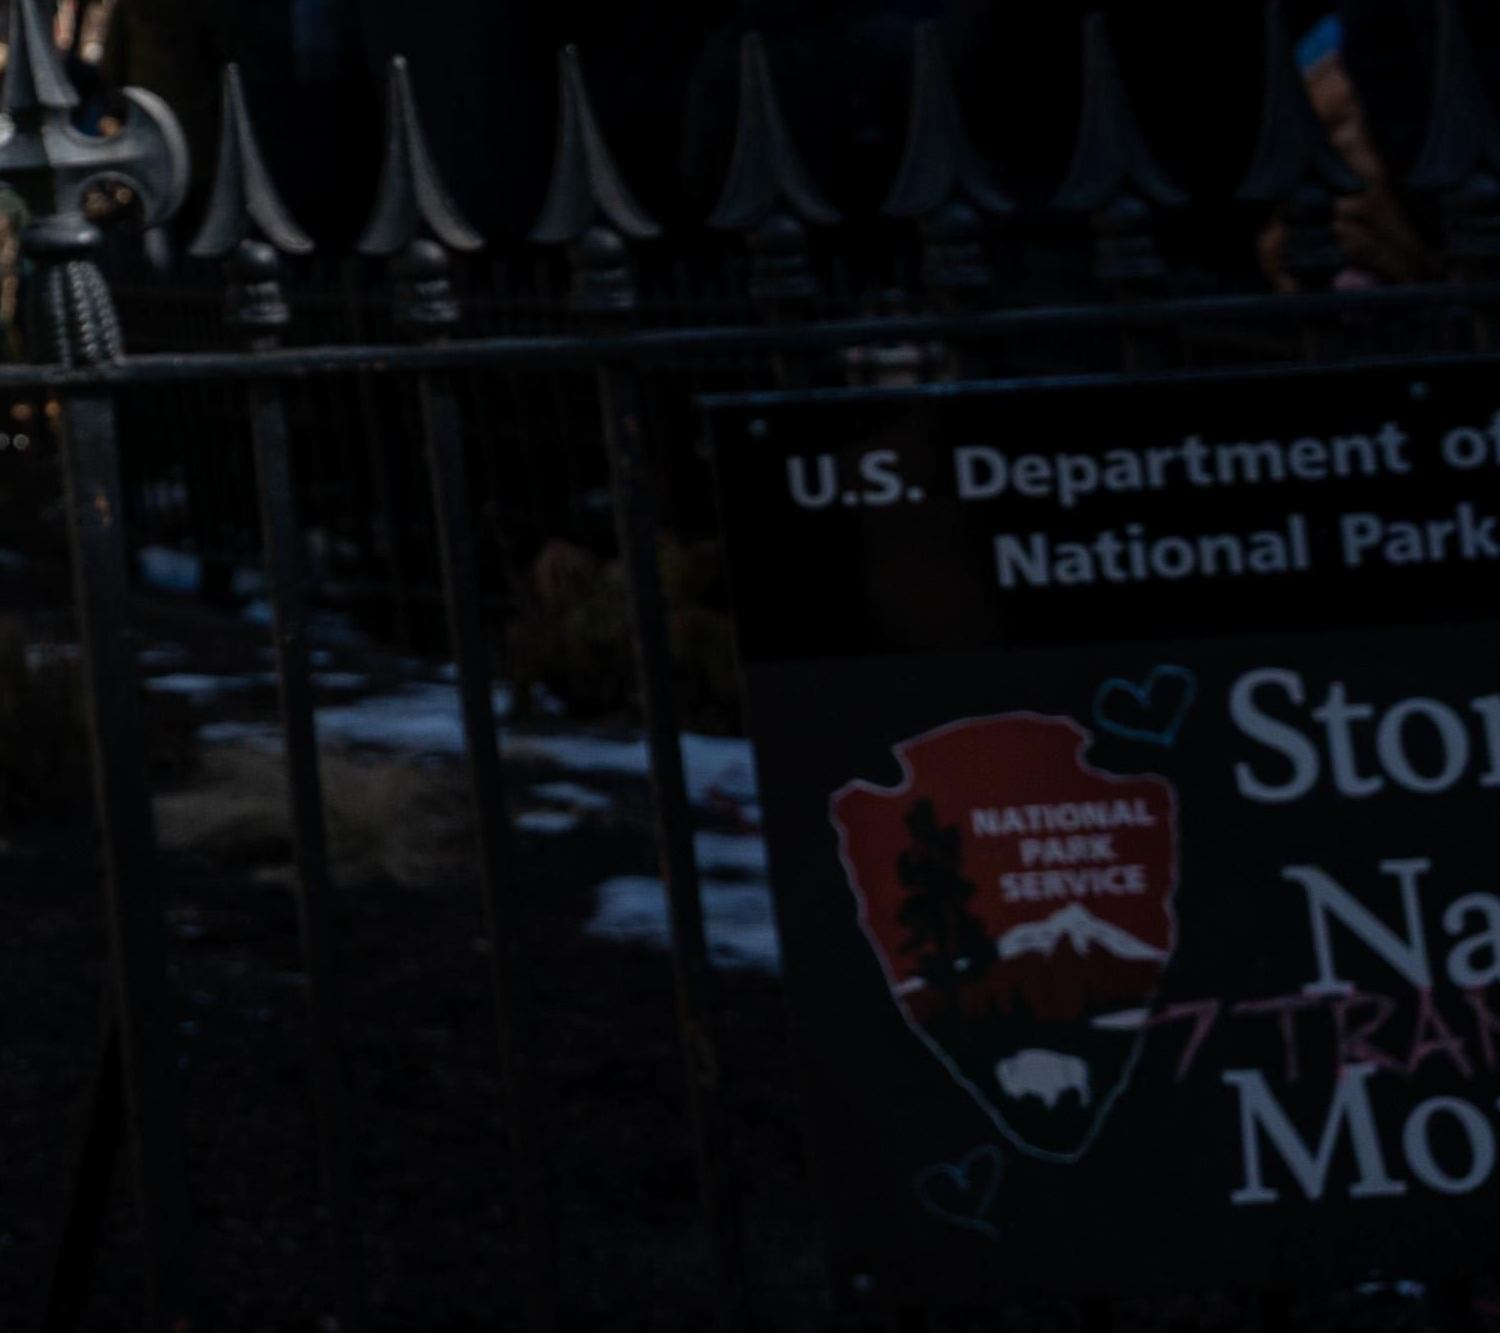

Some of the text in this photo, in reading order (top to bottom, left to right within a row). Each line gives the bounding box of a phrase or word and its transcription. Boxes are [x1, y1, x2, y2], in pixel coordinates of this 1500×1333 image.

[786, 448, 923, 510] U.S.
[953, 420, 1410, 506] Department
[993, 501, 1500, 591] National Park
[970, 796, 1158, 838] NATIONAL
[1018, 832, 1117, 868] PARK
[997, 863, 1149, 903] SERVICE
[1281, 856, 1500, 998] Na
[1222, 1060, 1500, 1208] Mo
